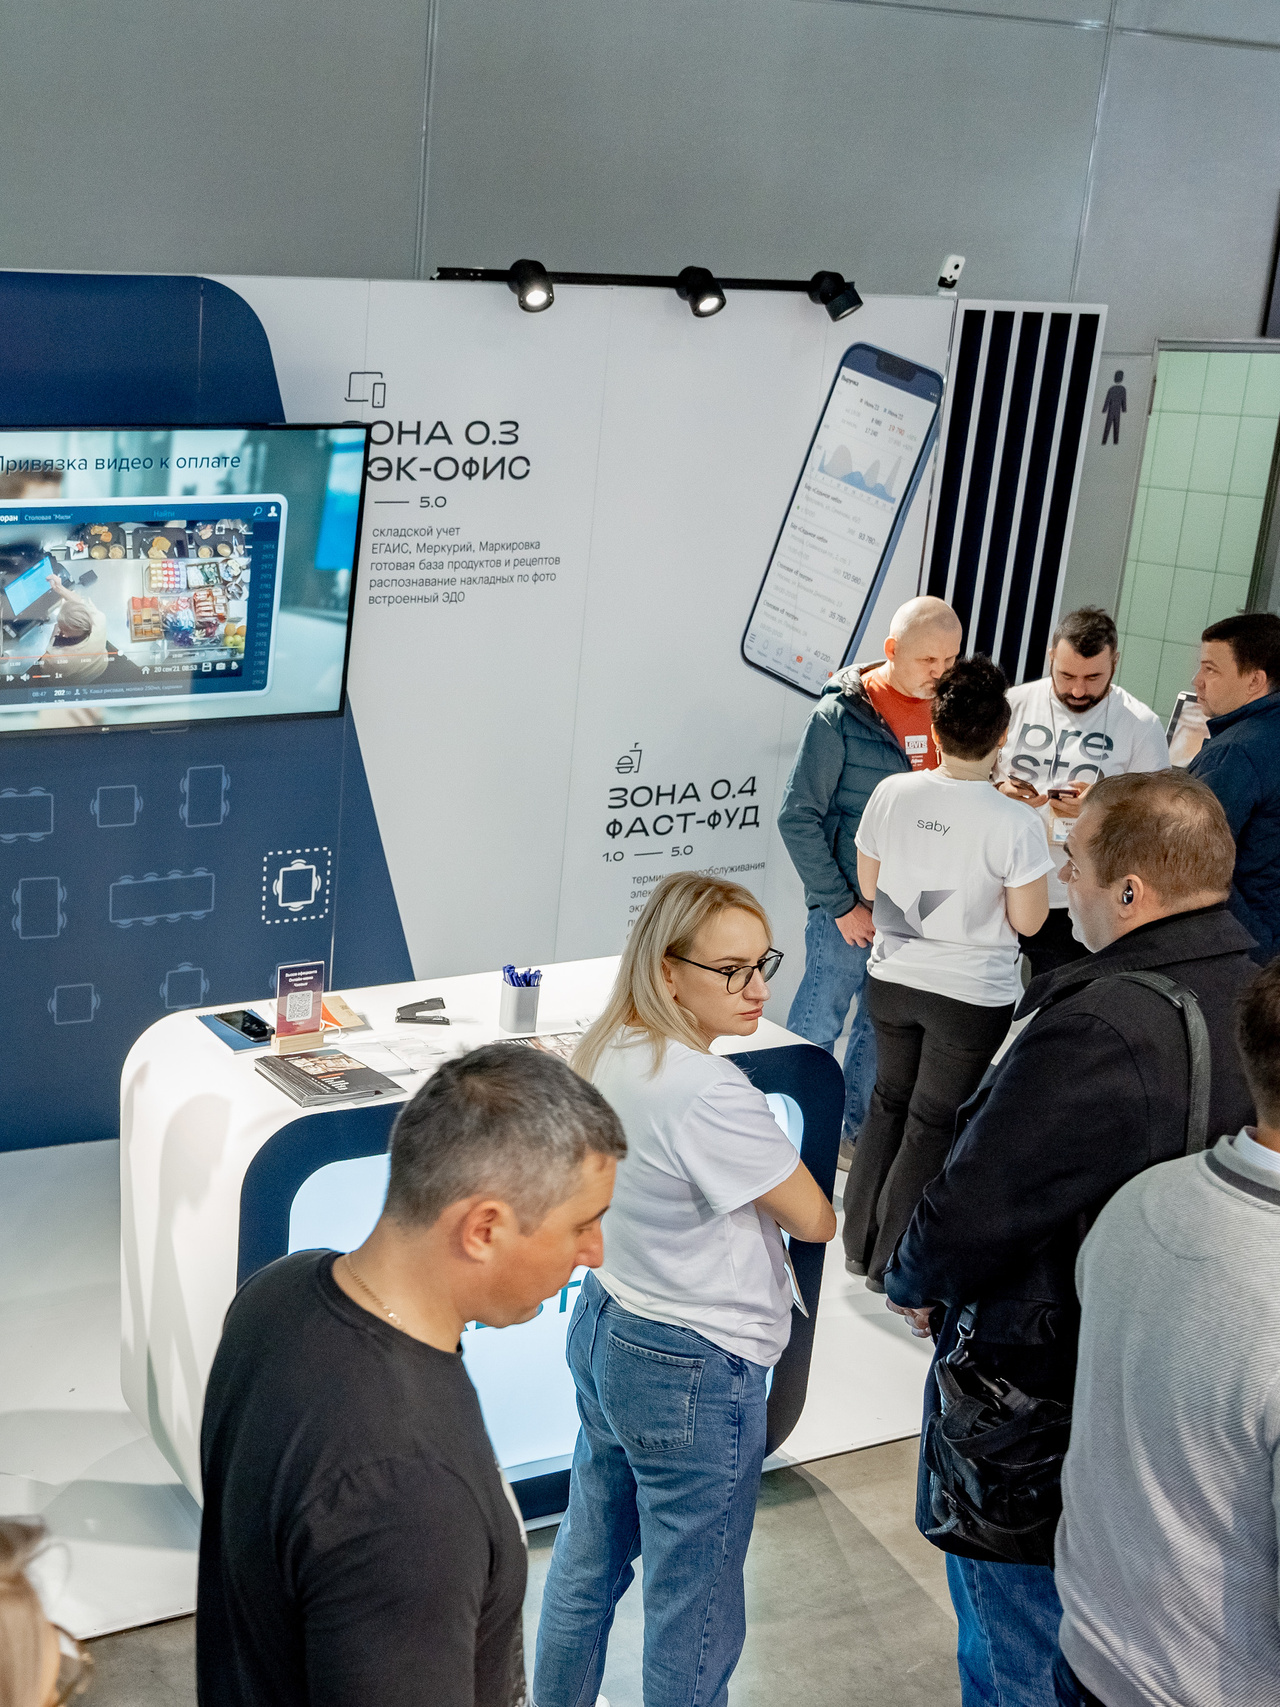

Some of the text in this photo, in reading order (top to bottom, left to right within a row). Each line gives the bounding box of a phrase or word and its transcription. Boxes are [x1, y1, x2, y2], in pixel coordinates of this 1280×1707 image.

[341, 419, 520, 446] ОНА 0.3
[95, 456, 154, 473] видео
[159, 457, 170, 470] к
[176, 455, 241, 470] оплате
[367, 455, 531, 482] ЭК-ОФИС
[419, 496, 447, 508] 5.0
[372, 526, 461, 539] складской учет
[371, 540, 541, 556] ЕГАИС, Меркурий, Маркировка
[370, 555, 561, 572] готовая база продуктов и рецептов
[369, 572, 557, 590] распознавание накладных по фото
[368, 591, 466, 607] встроенный ЭДО
[1013, 722, 1114, 762] pre
[1011, 753, 1105, 784] sto
[607, 776, 757, 810] ЗОНА 0.4
[605, 805, 760, 839] ФАСТ-ФУД
[916, 819, 951, 836] saby
[602, 845, 694, 863] 1.0 5.0
